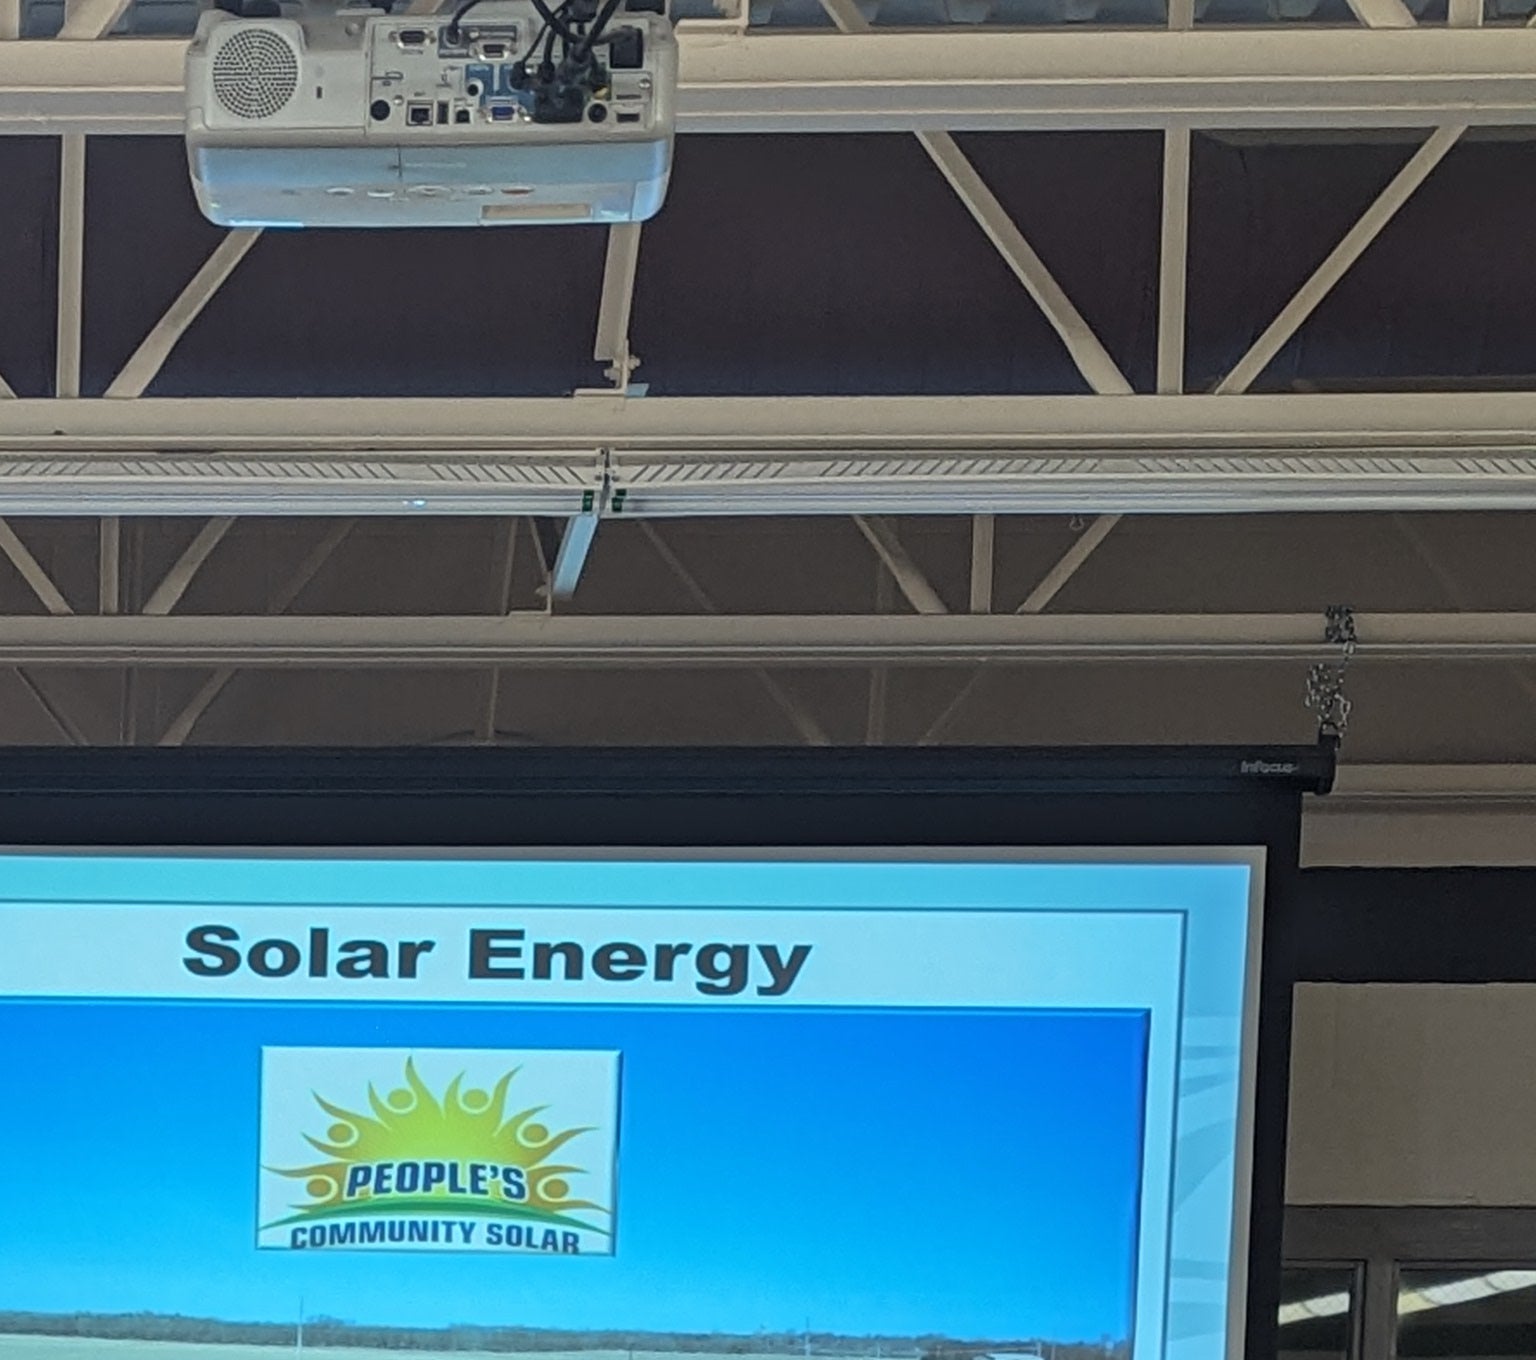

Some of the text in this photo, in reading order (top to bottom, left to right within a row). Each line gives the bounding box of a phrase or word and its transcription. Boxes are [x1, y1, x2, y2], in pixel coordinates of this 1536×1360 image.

[183, 925, 812, 997] Solar Energy
[346, 1161, 527, 1200] PEOPLE'S
[291, 1220, 580, 1254] COMMUNITY SOLAR
